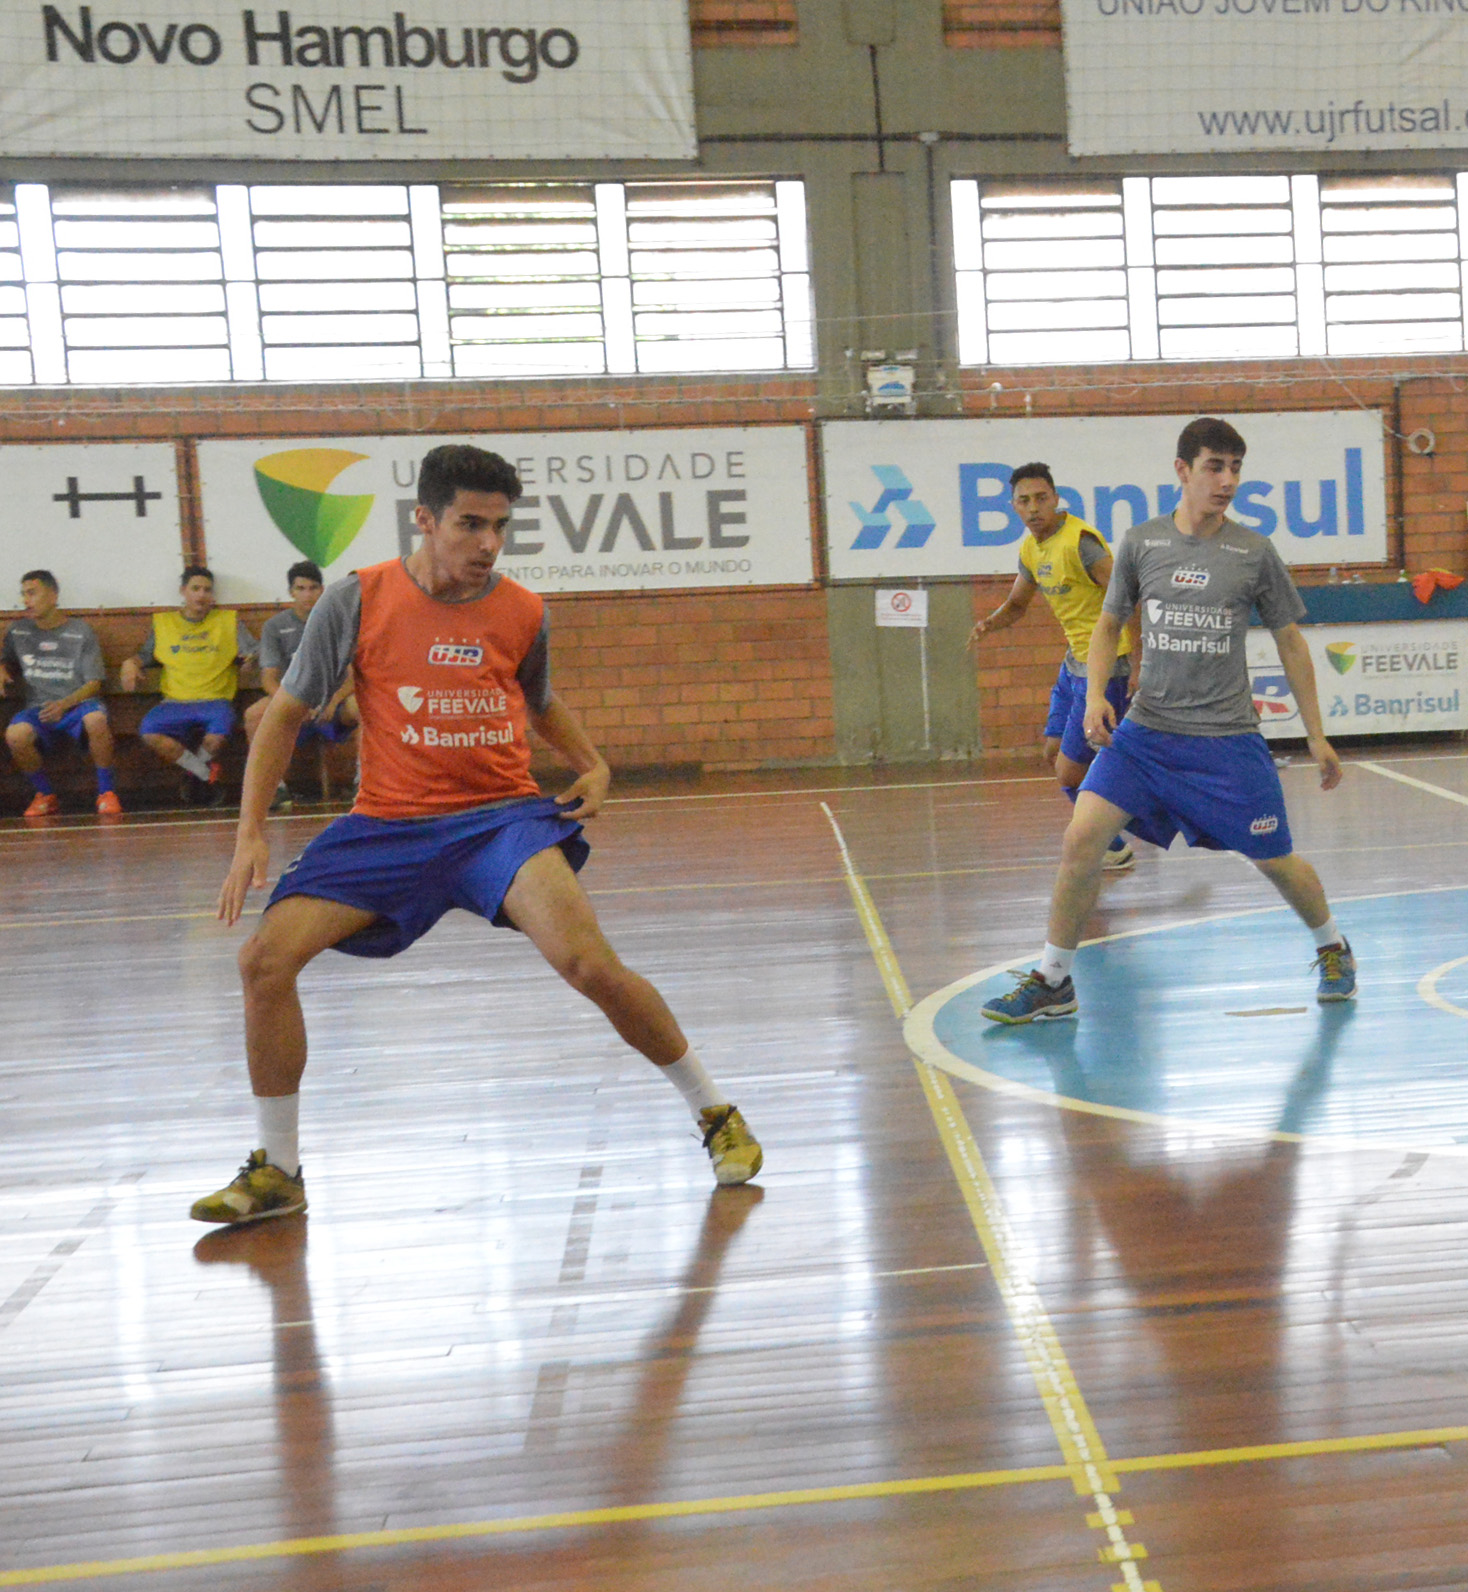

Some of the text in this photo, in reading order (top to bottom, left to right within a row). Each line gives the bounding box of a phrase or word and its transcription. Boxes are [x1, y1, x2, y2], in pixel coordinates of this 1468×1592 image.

[1215, 0, 1330, 14] JOVEM
[43, 5, 579, 84] Novo Hamburgo
[245, 82, 428, 135] SMEL
[392, 451, 746, 488] UERSIDADE
[959, 448, 1365, 547] Bnrsul
[395, 489, 750, 556] FEVALE
[550, 565, 594, 579] PARA
[600, 562, 664, 577] INOVAR
[668, 561, 682, 575] O
[685, 559, 752, 574] MUNDO
[1164, 611, 1232, 629] FEEVALE
[1158, 633, 1231, 654] Banrisul
[1362, 652, 1458, 673] FEEVALE
[428, 696, 507, 714] FEEVALE
[1355, 689, 1460, 716] Banrisul
[423, 721, 514, 747] Banrisul
